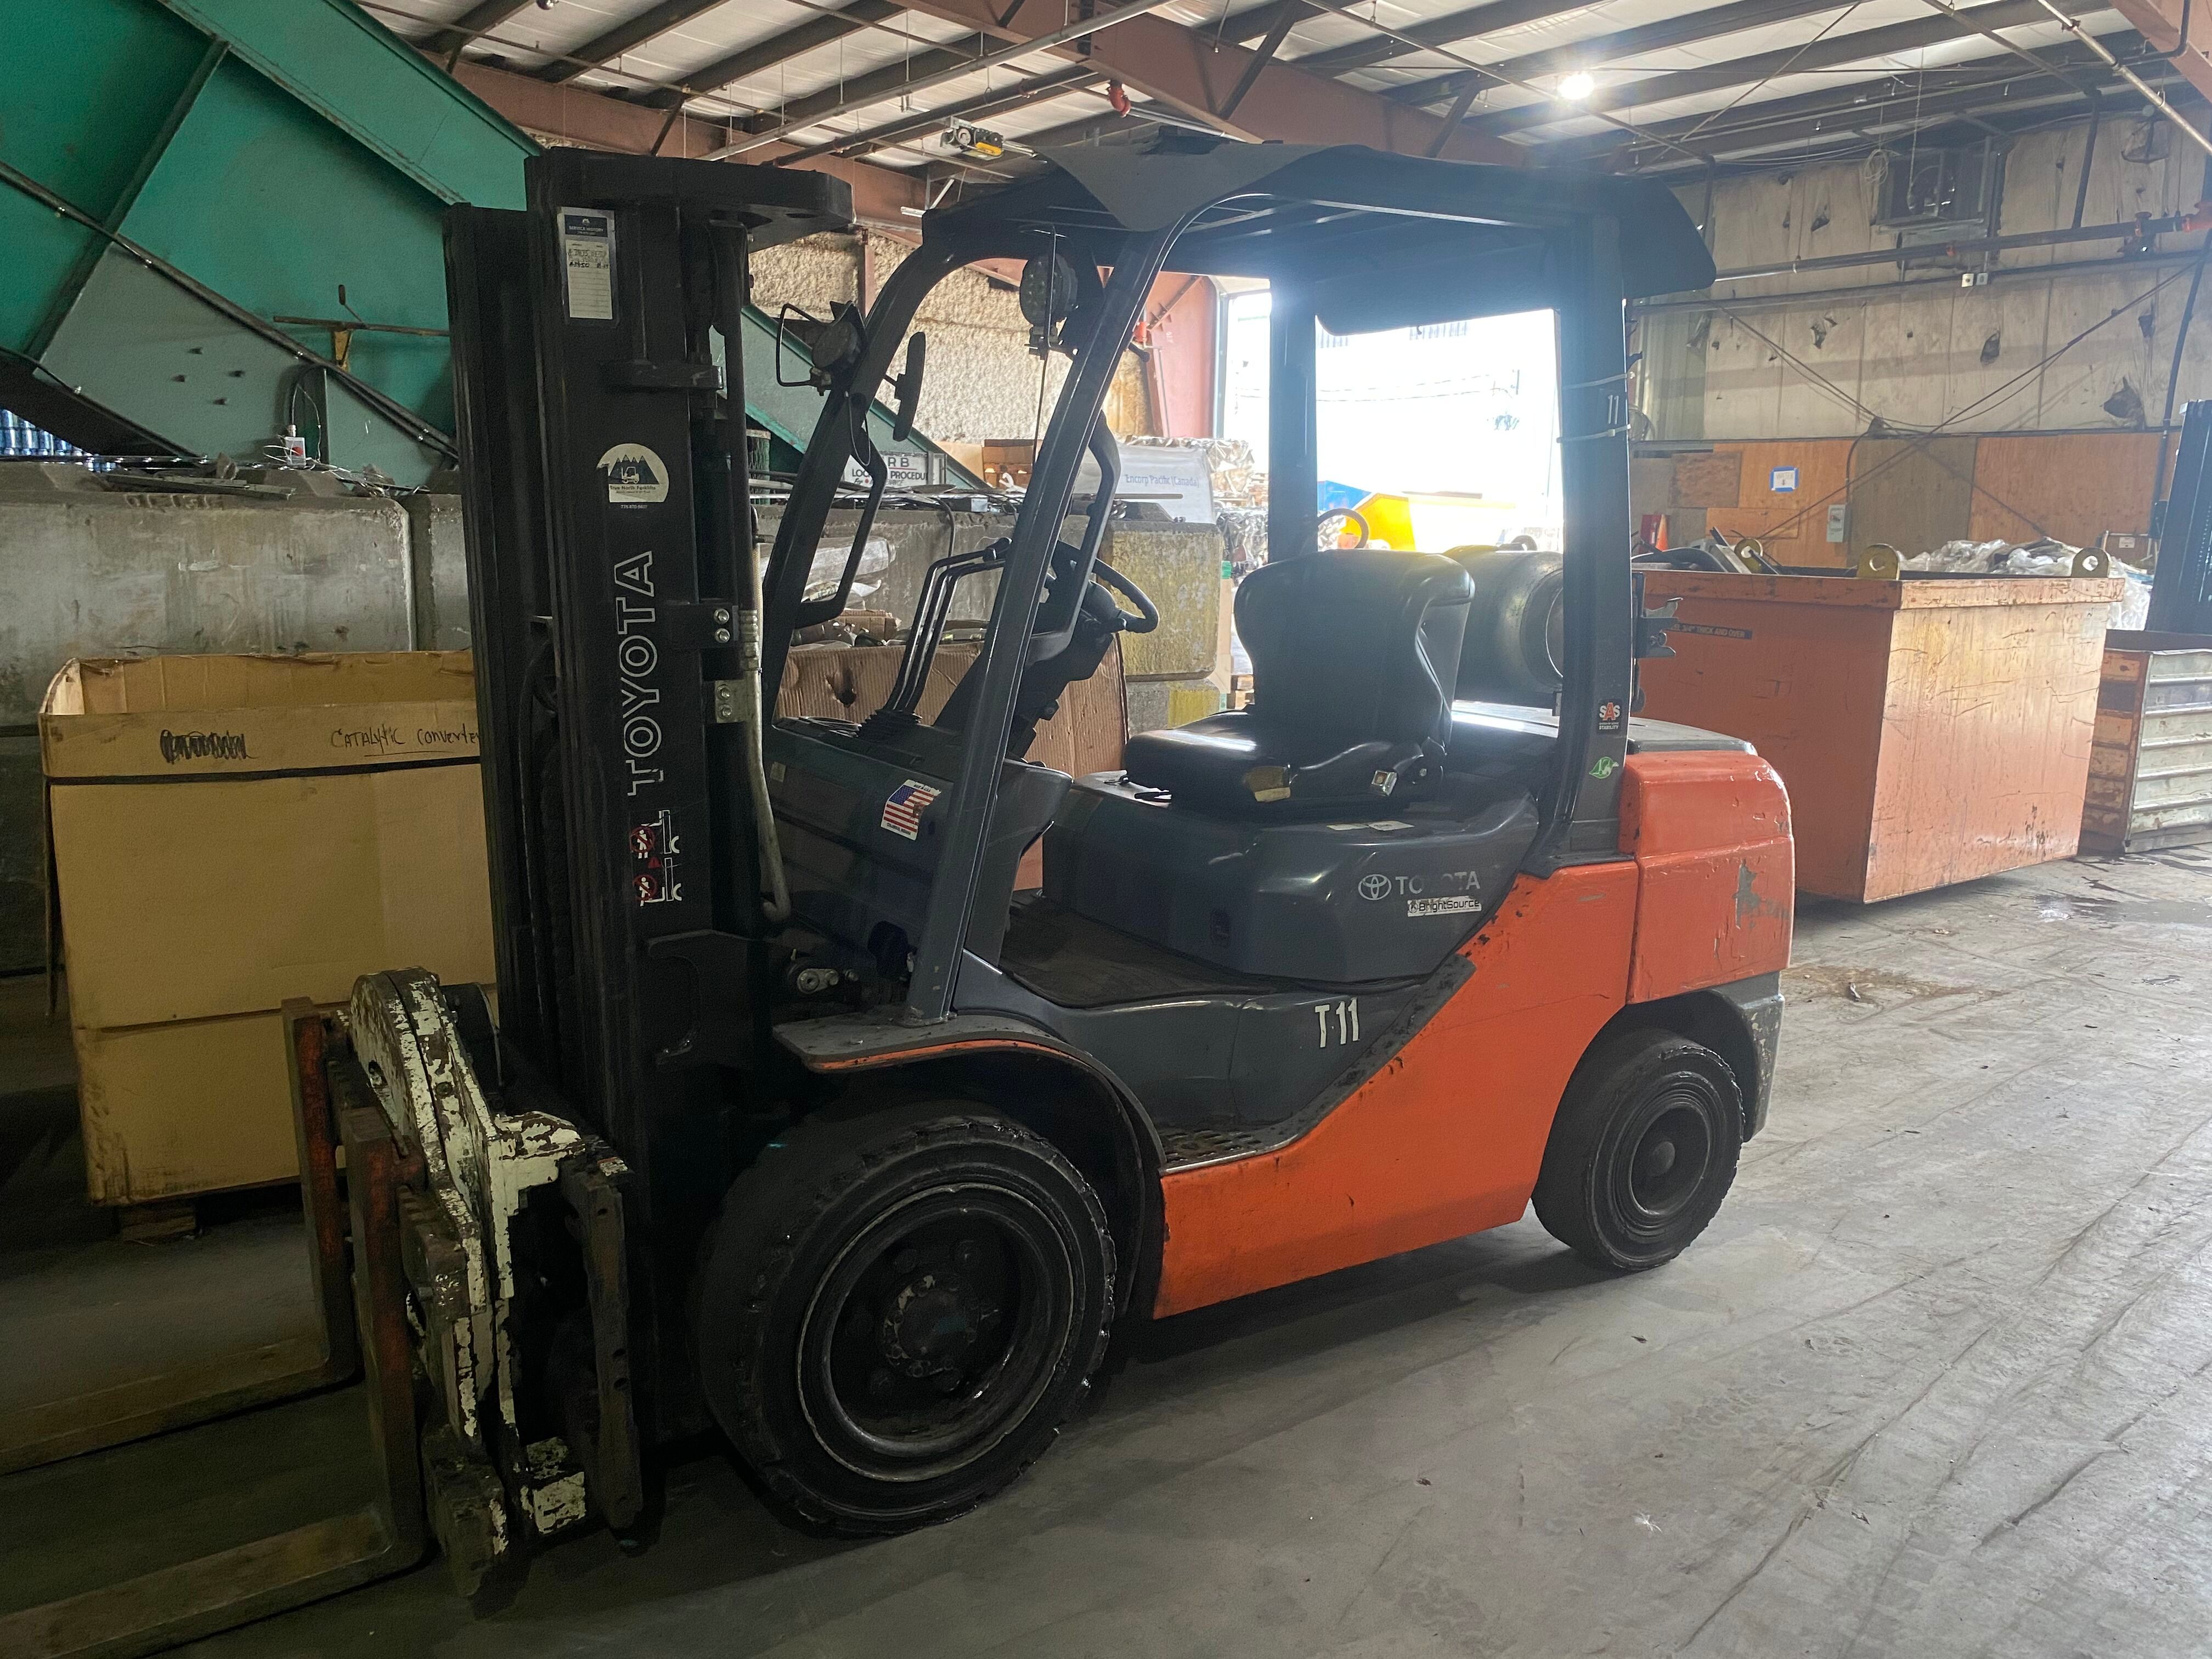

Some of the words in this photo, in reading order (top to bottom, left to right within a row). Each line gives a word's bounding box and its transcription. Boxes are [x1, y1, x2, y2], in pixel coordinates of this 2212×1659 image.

[1607, 394, 1619, 425] 11
[890, 471, 934, 480] PROCEDU
[614, 550, 664, 796] TOYOTA
[1599, 702, 1621, 720] SAS
[1419, 900, 1480, 913] BrightSource
[1314, 997, 1359, 1048] T11
